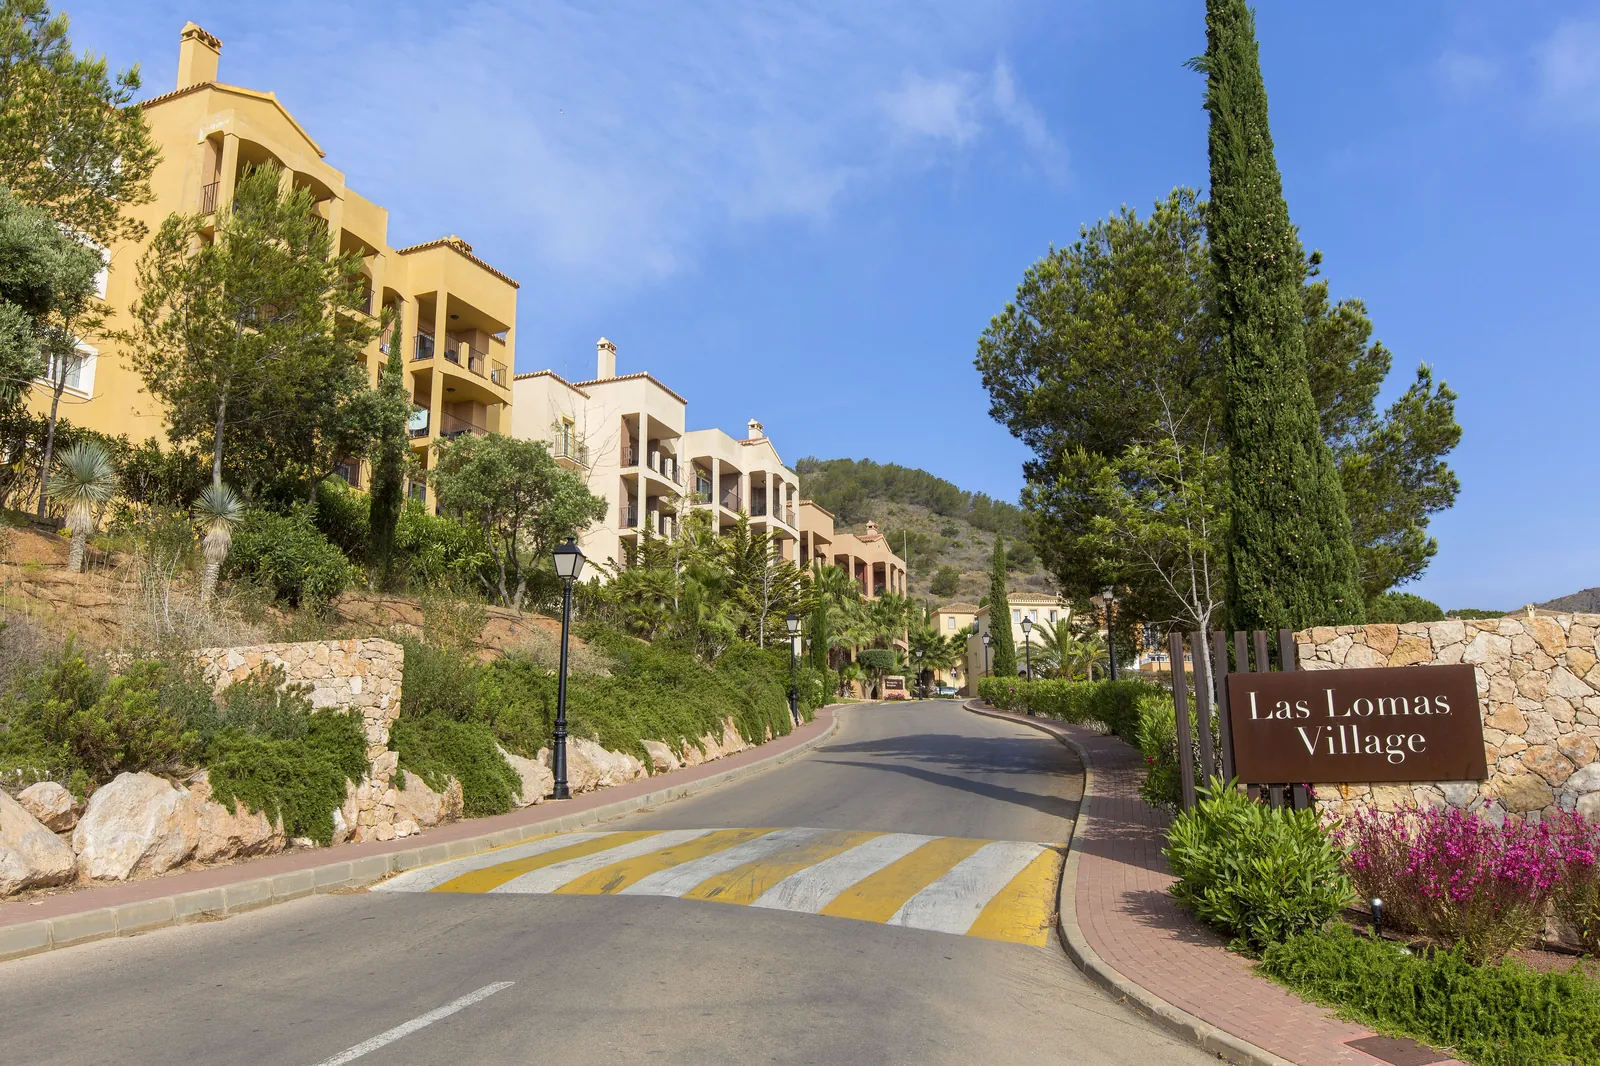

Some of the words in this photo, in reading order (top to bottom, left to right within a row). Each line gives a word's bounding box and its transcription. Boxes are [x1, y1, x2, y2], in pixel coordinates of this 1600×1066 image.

[1247, 691, 1311, 720] Las
[1322, 688, 1451, 718] Lomas
[1294, 724, 1426, 764] Village
